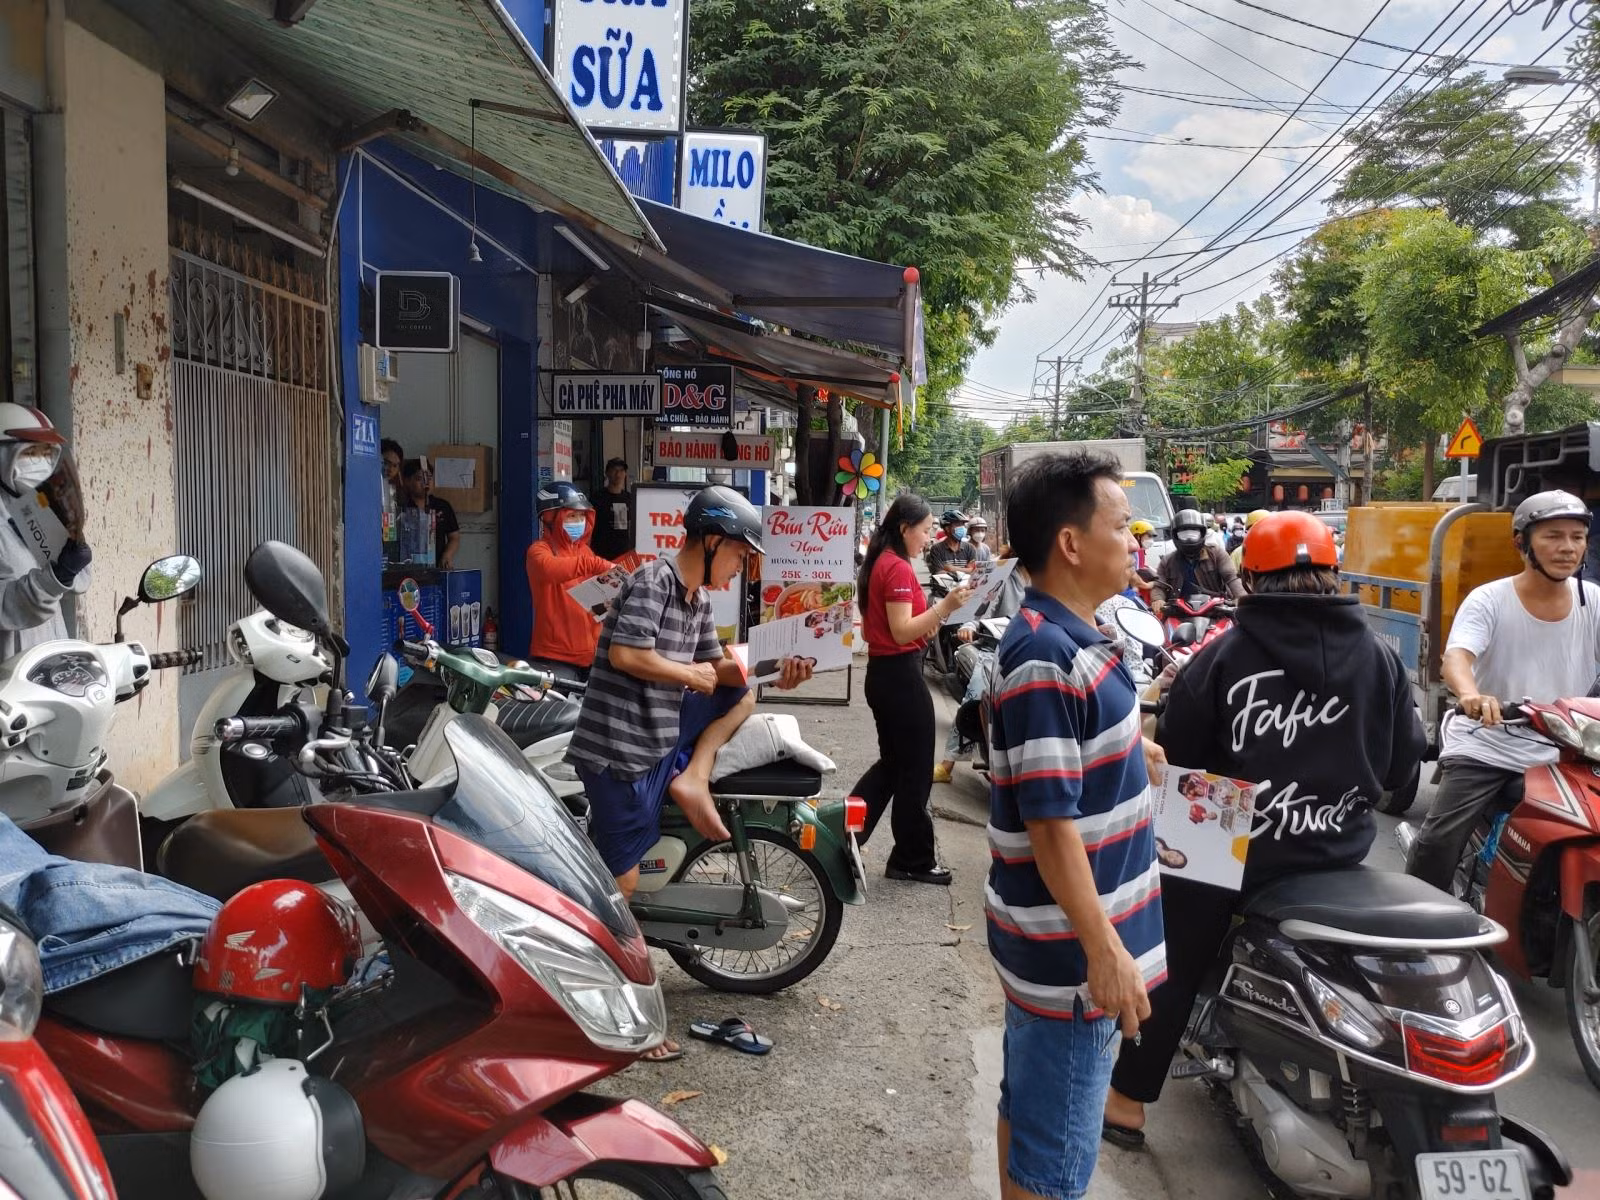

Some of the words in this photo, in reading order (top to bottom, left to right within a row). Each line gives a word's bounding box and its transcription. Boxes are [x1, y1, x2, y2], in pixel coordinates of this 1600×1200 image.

[570, 27, 663, 111] SỮA
[689, 148, 754, 189] MILO
[559, 379, 575, 410] CÀ
[578, 379, 600, 410] PHÊ
[603, 384, 627, 410] PHA
[630, 379, 655, 410] MÁY
[663, 383, 726, 410] D&G
[711, 414, 729, 424] HÀNH
[659, 436, 682, 458] BẢO
[685, 440, 717, 459] HÀNH
[27, 519, 51, 560] NOVA
[767, 510, 803, 536] Bún
[807, 511, 849, 542] Riêu
[781, 570, 801, 579] 25K
[811, 571, 832, 579] 30K
[1227, 669, 1350, 752] Fafic
[1507, 825, 1531, 853] YAMAHA
[1433, 1159, 1512, 1194] 59-G2
